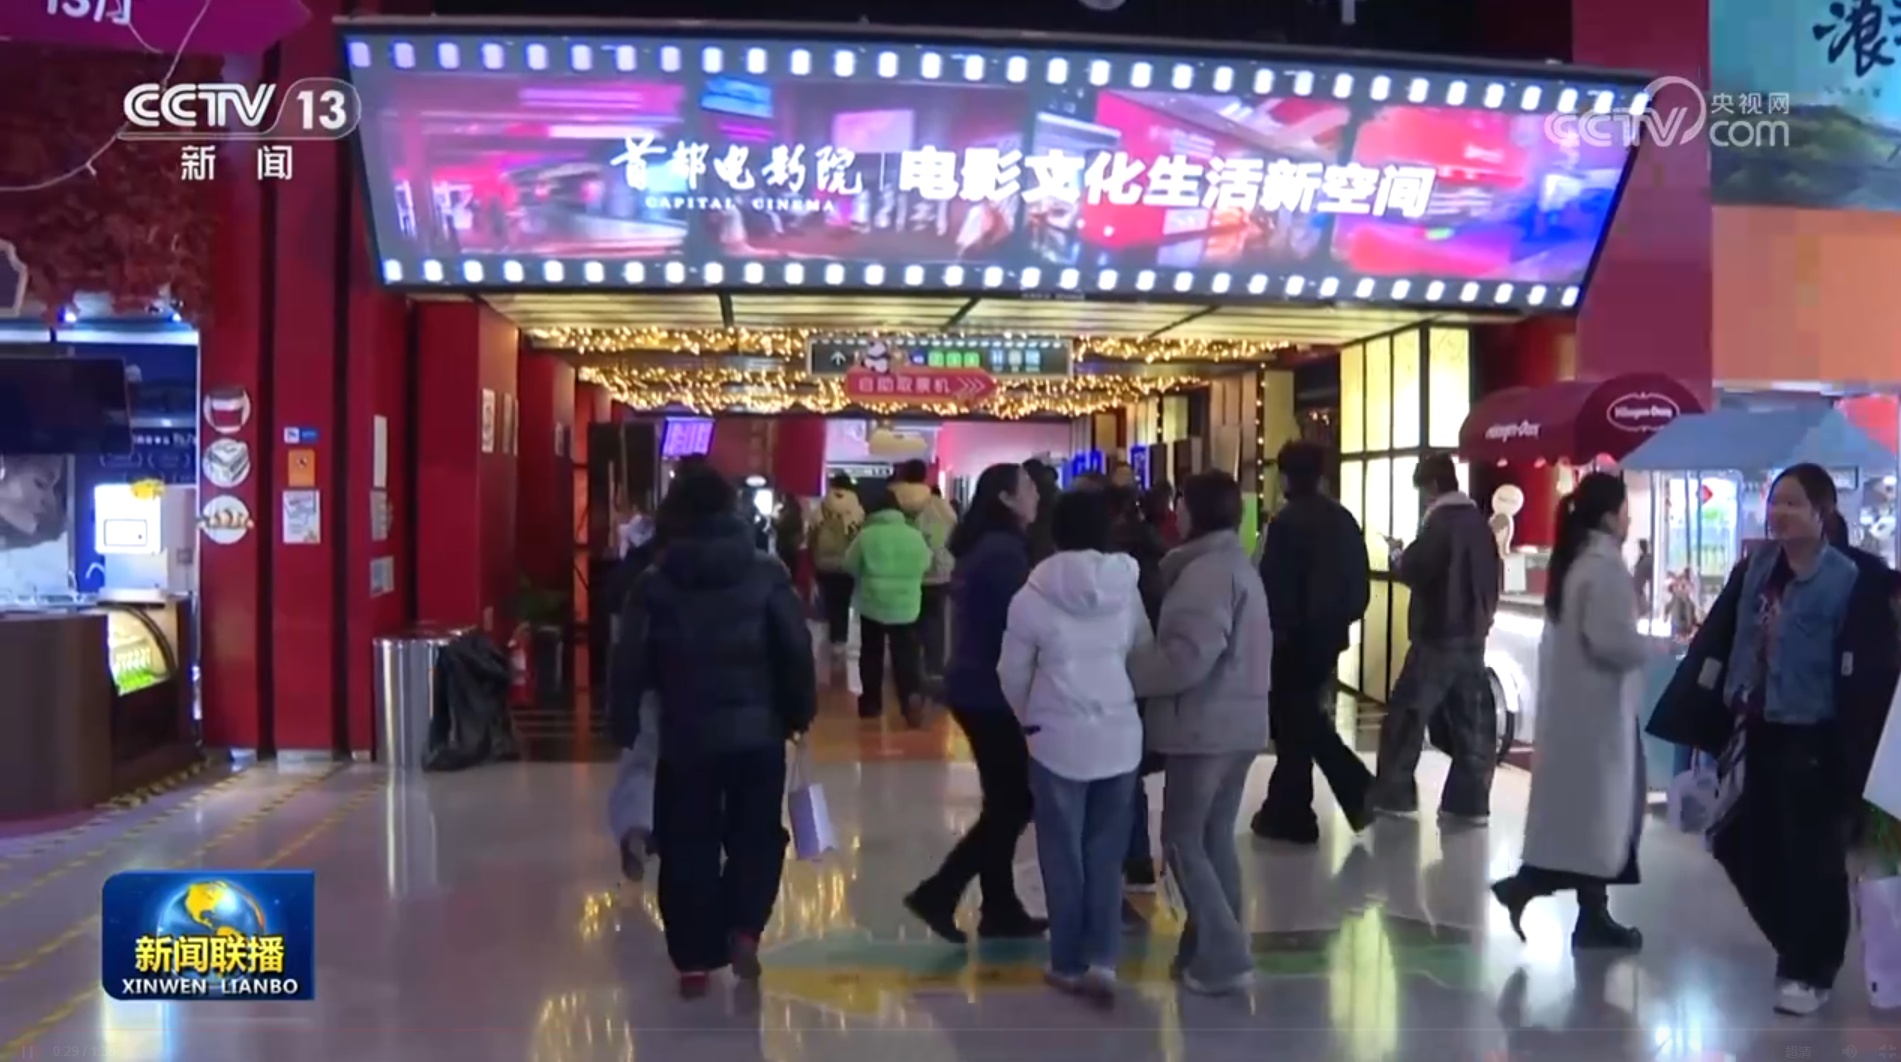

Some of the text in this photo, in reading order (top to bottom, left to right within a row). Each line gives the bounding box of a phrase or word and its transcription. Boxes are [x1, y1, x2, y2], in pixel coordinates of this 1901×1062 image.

[610, 134, 863, 194] 首都电影院
[899, 145, 1437, 218] 电影文化生活新空间
[645, 196, 836, 212] CAPITAL CINEMA
